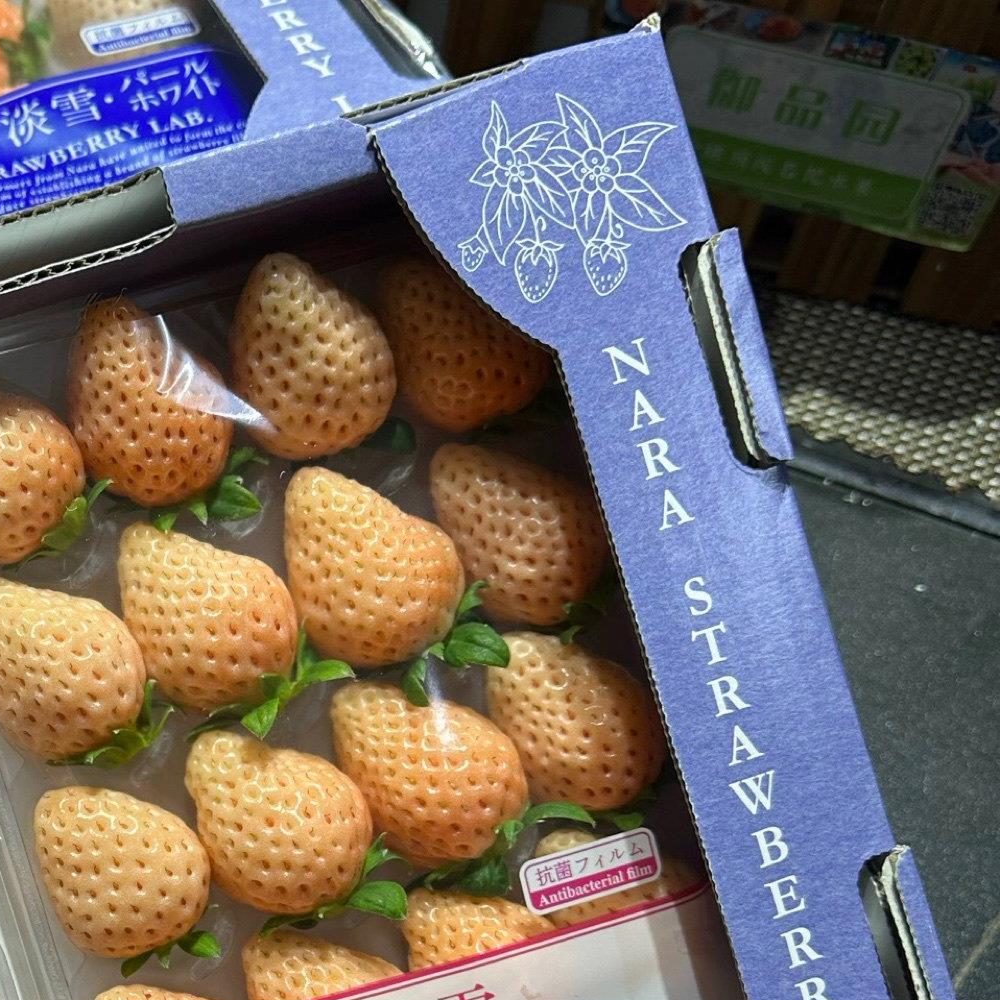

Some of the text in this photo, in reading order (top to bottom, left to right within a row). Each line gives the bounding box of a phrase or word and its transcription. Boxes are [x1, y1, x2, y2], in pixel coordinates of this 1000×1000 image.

[129, 73, 221, 112] ホワイト
[147, 110, 214, 134] LAB.
[602, 337, 696, 531] NARA
[535, 842, 644, 887] 抗菌フィルム
[538, 864, 653, 907] Antibacterial film
